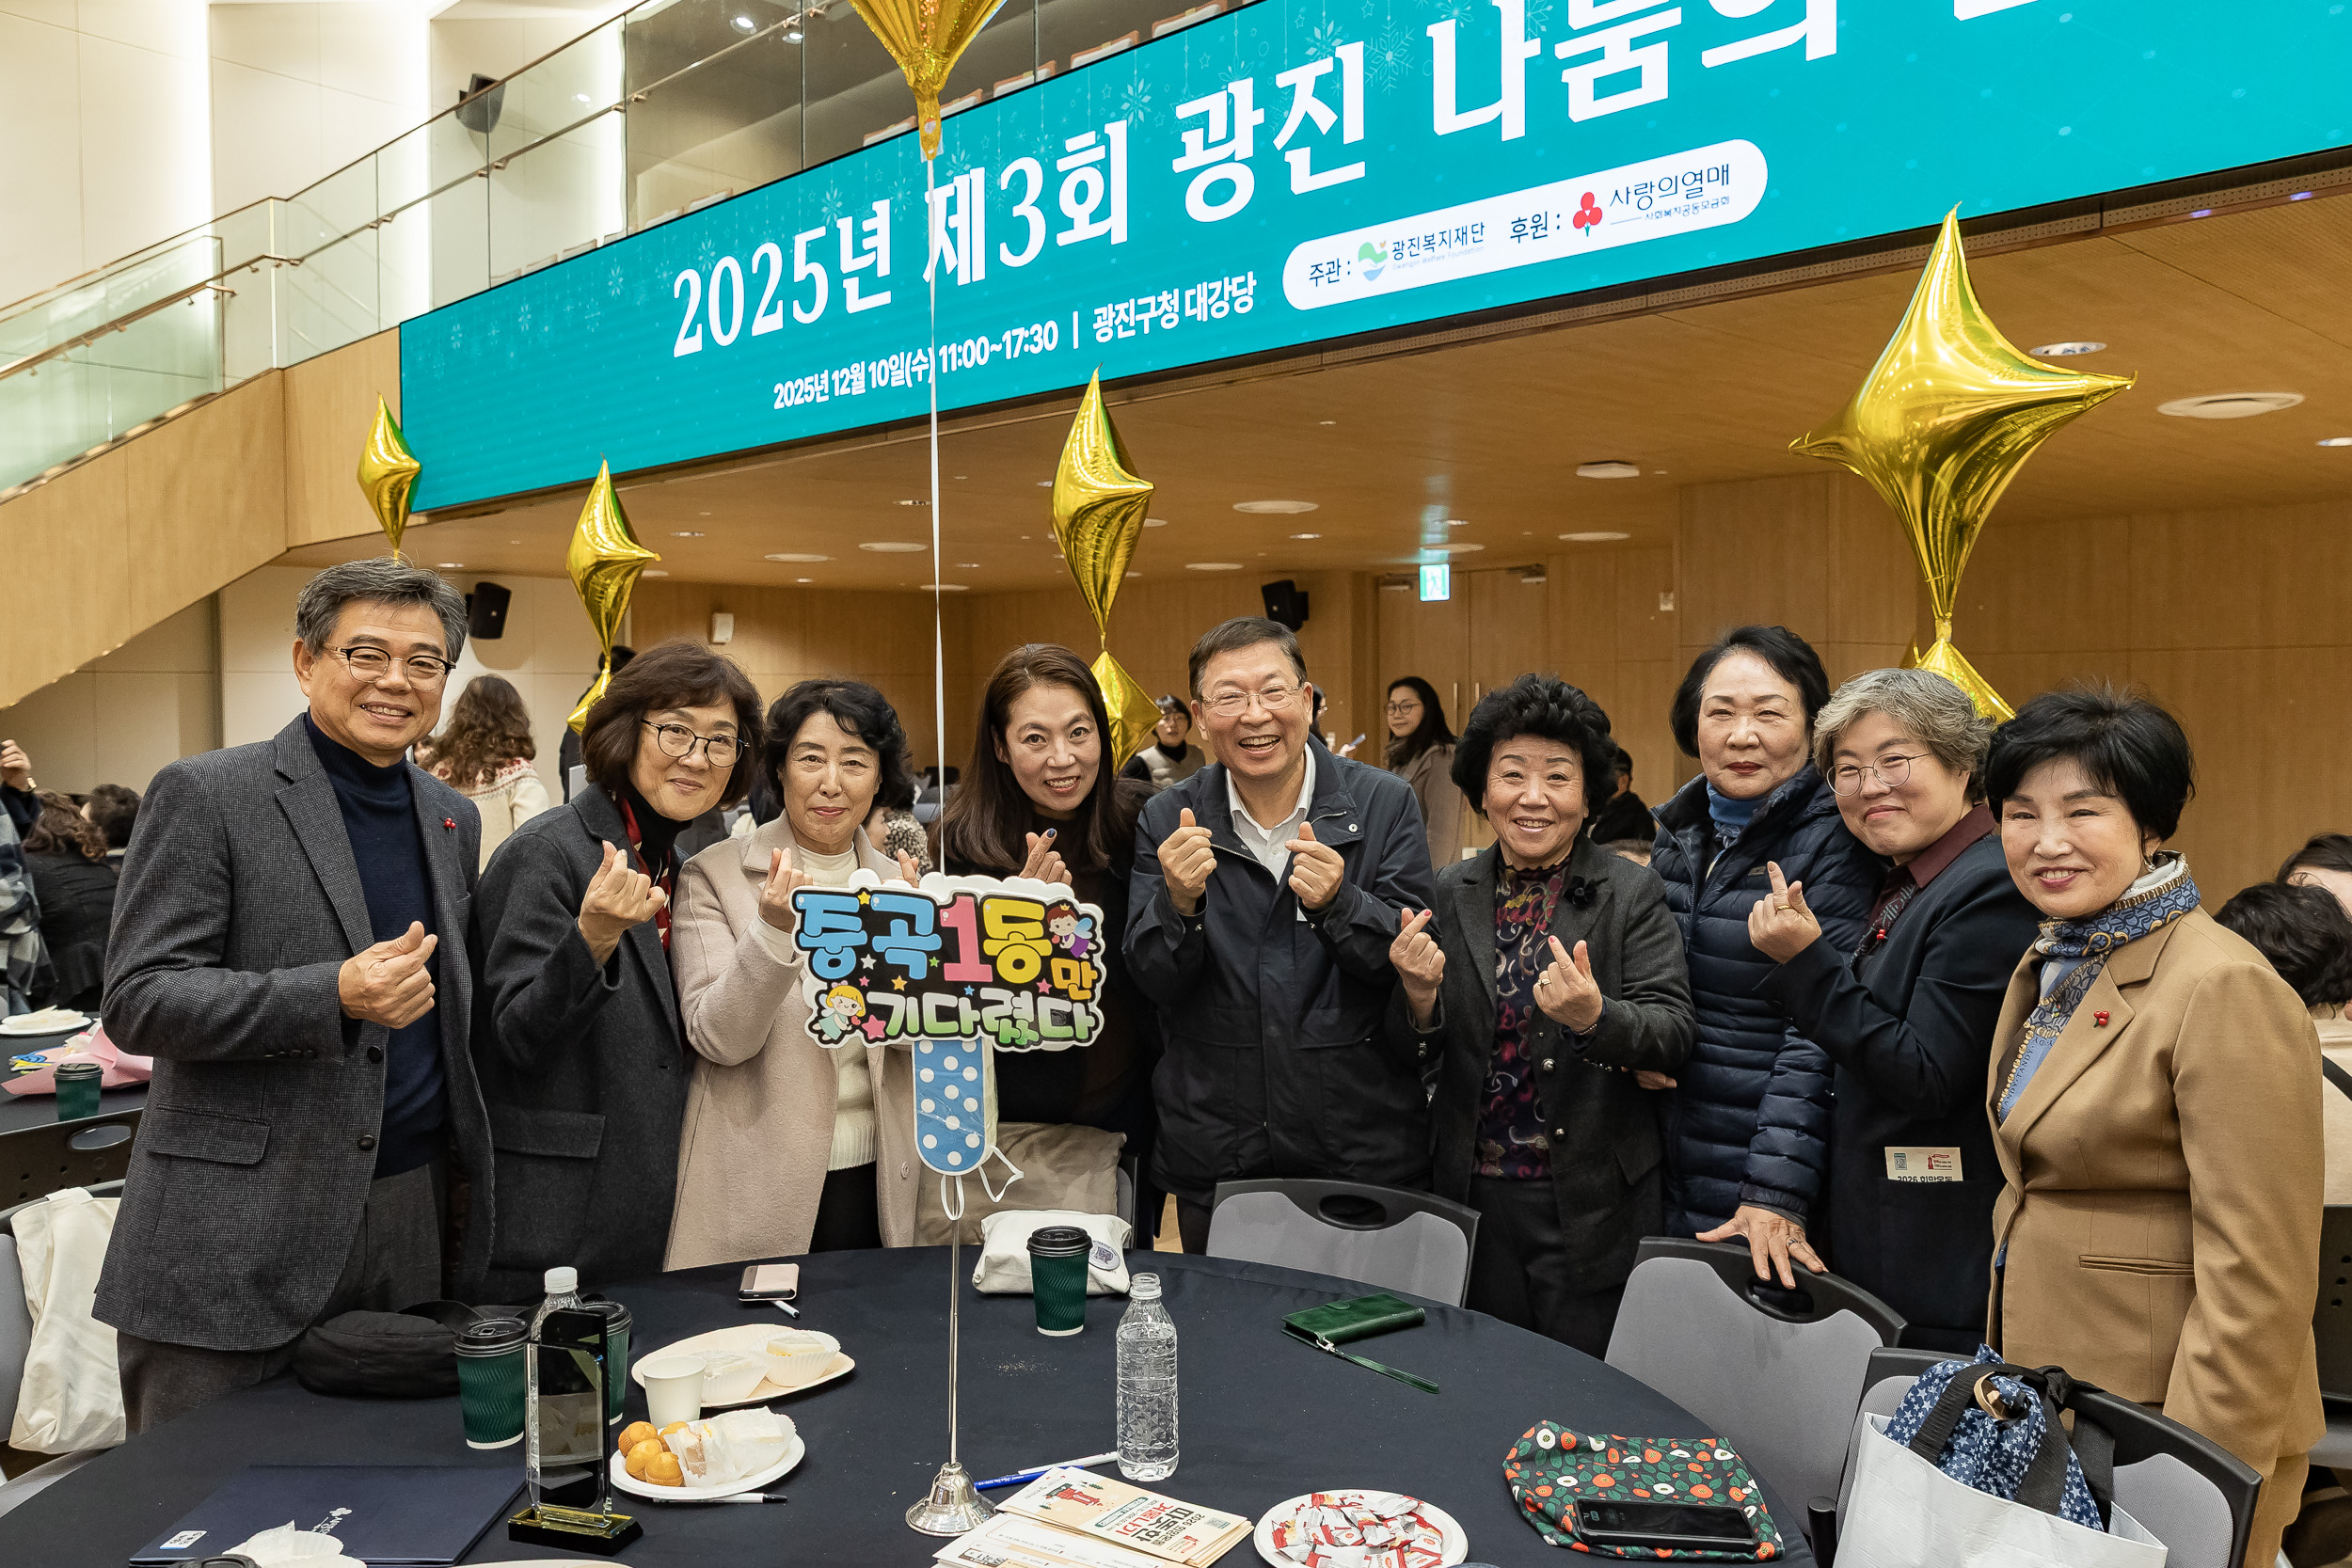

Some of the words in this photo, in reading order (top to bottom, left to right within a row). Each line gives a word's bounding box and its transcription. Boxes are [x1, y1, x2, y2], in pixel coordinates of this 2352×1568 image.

[674, 199, 891, 357] 2025년
[923, 119, 1127, 286] 제3회
[1173, 41, 1365, 222] 광진
[1610, 164, 1729, 211] 사랑의열매
[1392, 222, 1485, 261] 광진복지재단
[1510, 212, 1549, 244] 후원
[1310, 258, 1342, 287] 주관
[773, 372, 829, 409] 2025년
[831, 361, 866, 396] 12월
[867, 347, 935, 389] 10일(수)
[938, 321, 1059, 373] 11:00~17:30
[1092, 288, 1180, 342] 광진구청
[1184, 271, 1257, 323] 대강당
[866, 988, 1096, 1045] 기다렸다
[1115, 1502, 1174, 1536] 겨울나기
[1131, 1507, 1194, 1542] 따뜻한
[1183, 1513, 1205, 1527] 2026
